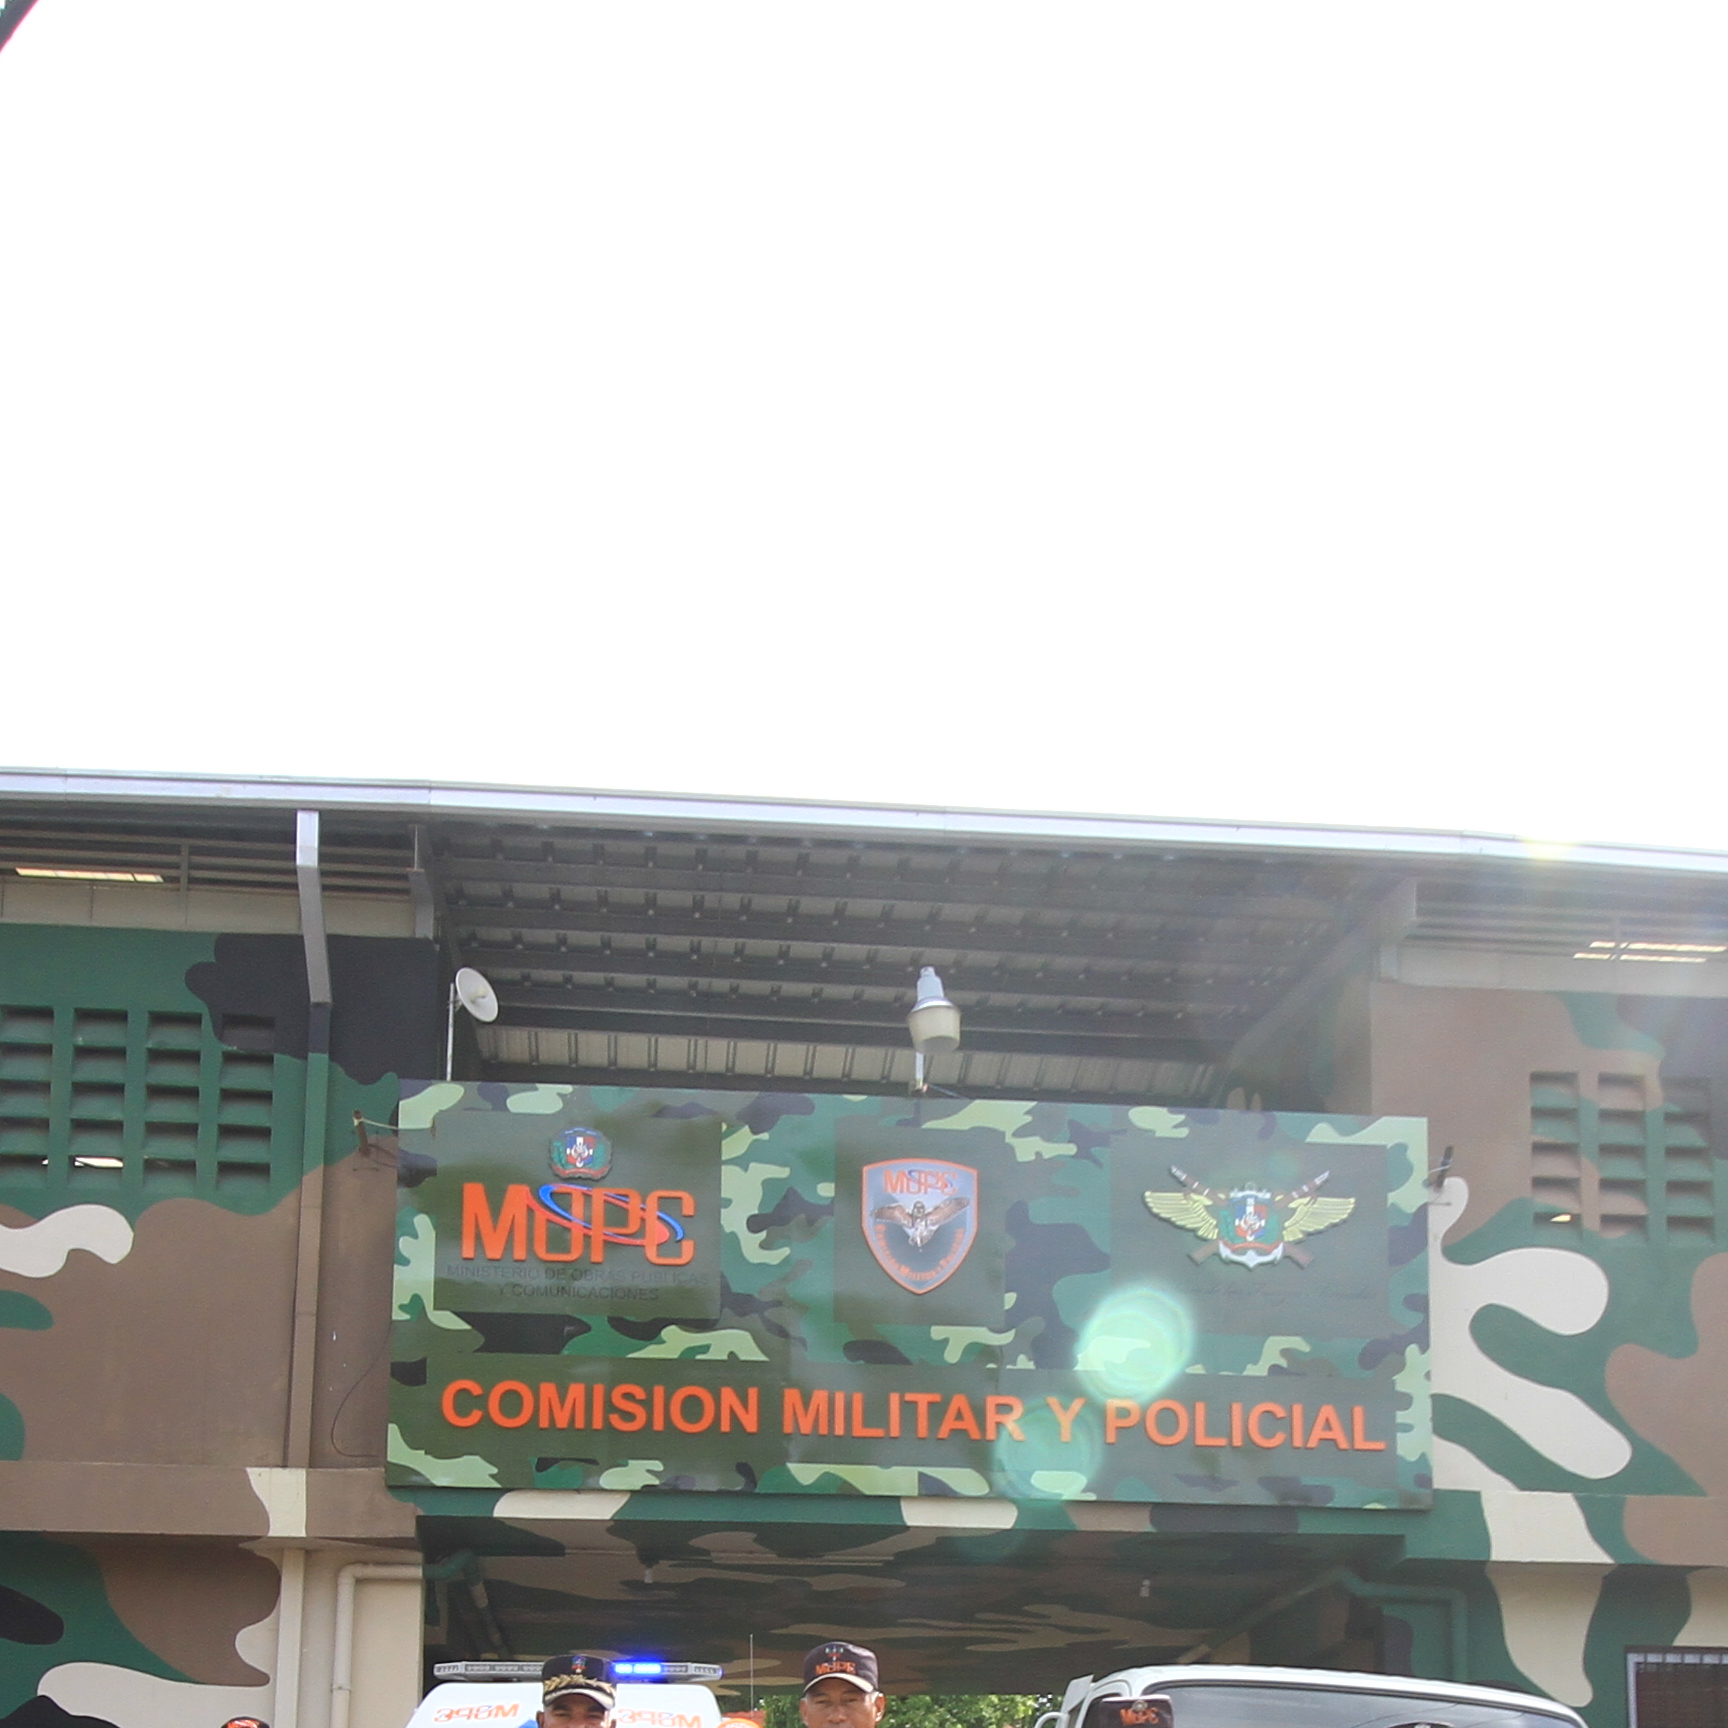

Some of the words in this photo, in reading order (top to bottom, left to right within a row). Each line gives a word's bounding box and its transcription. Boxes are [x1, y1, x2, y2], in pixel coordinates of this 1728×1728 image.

[884, 1169, 958, 1195] MOPC
[461, 1182, 695, 1265] MOPC
[447, 1264, 540, 1279] MINISTERIO
[544, 1267, 568, 1281] DE
[571, 1269, 624, 1283] OBRAS
[497, 1284, 509, 1297] Y
[510, 1284, 660, 1301] COMUNICACIONES
[441, 1379, 759, 1434] COMISION
[782, 1387, 1025, 1442] MILITAR
[1046, 1397, 1086, 1443] Y
[1104, 1398, 1387, 1451] POLICIAL
